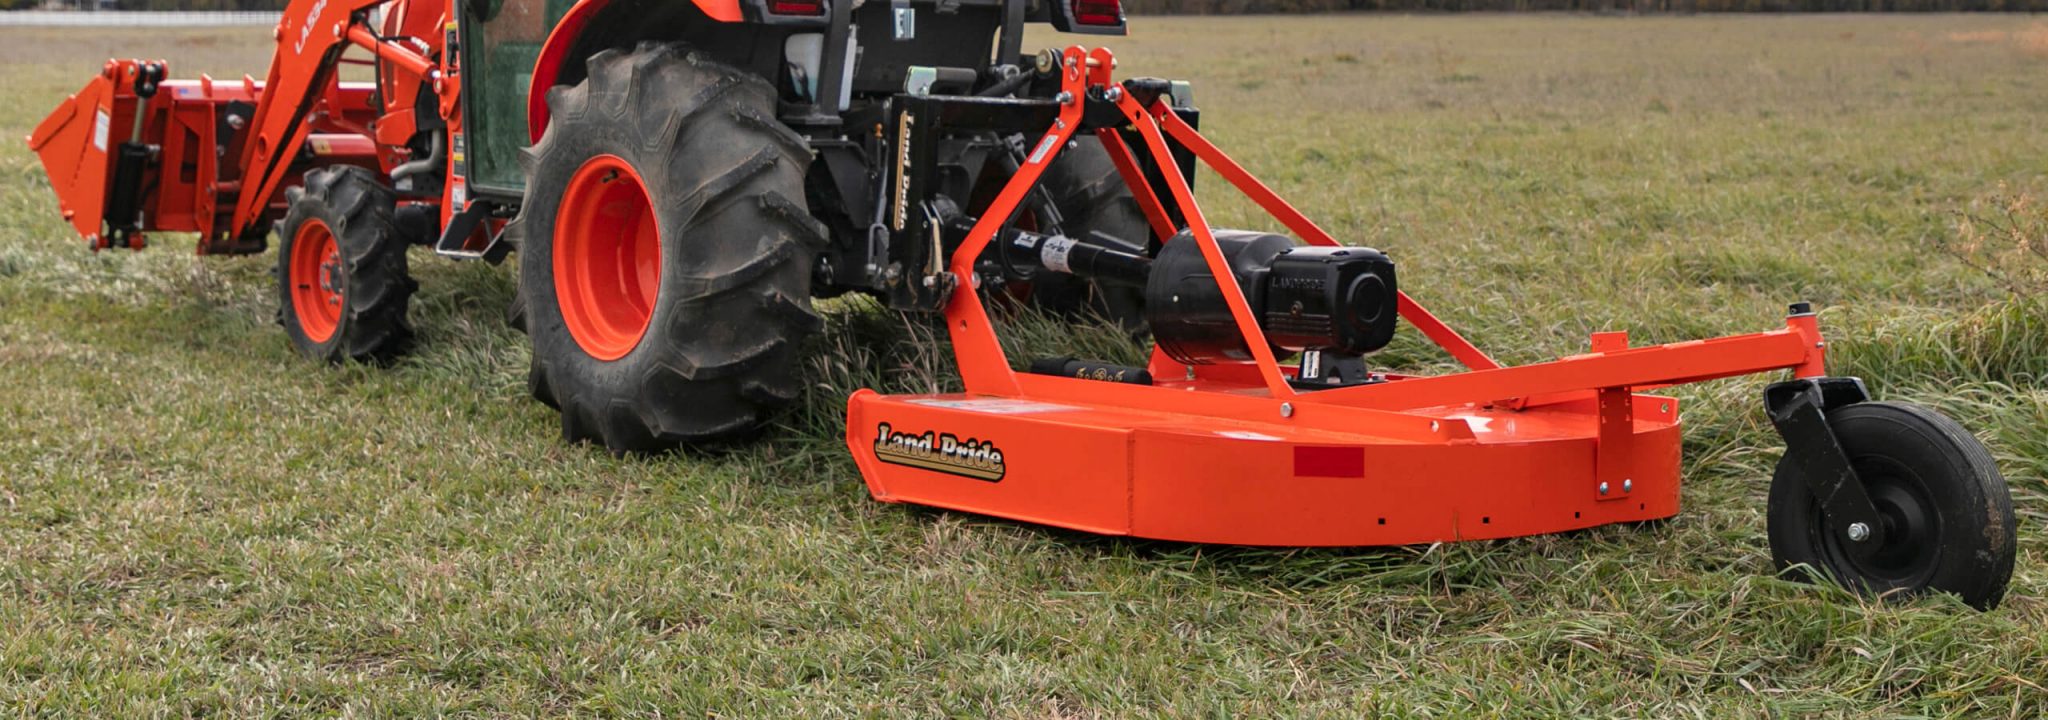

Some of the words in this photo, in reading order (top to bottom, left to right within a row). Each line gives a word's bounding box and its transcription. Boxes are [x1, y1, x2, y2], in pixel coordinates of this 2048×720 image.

[901, 114, 914, 168] Land
[899, 175, 911, 230] Pride
[878, 424, 934, 459] Land
[939, 435, 1002, 471] Pride
